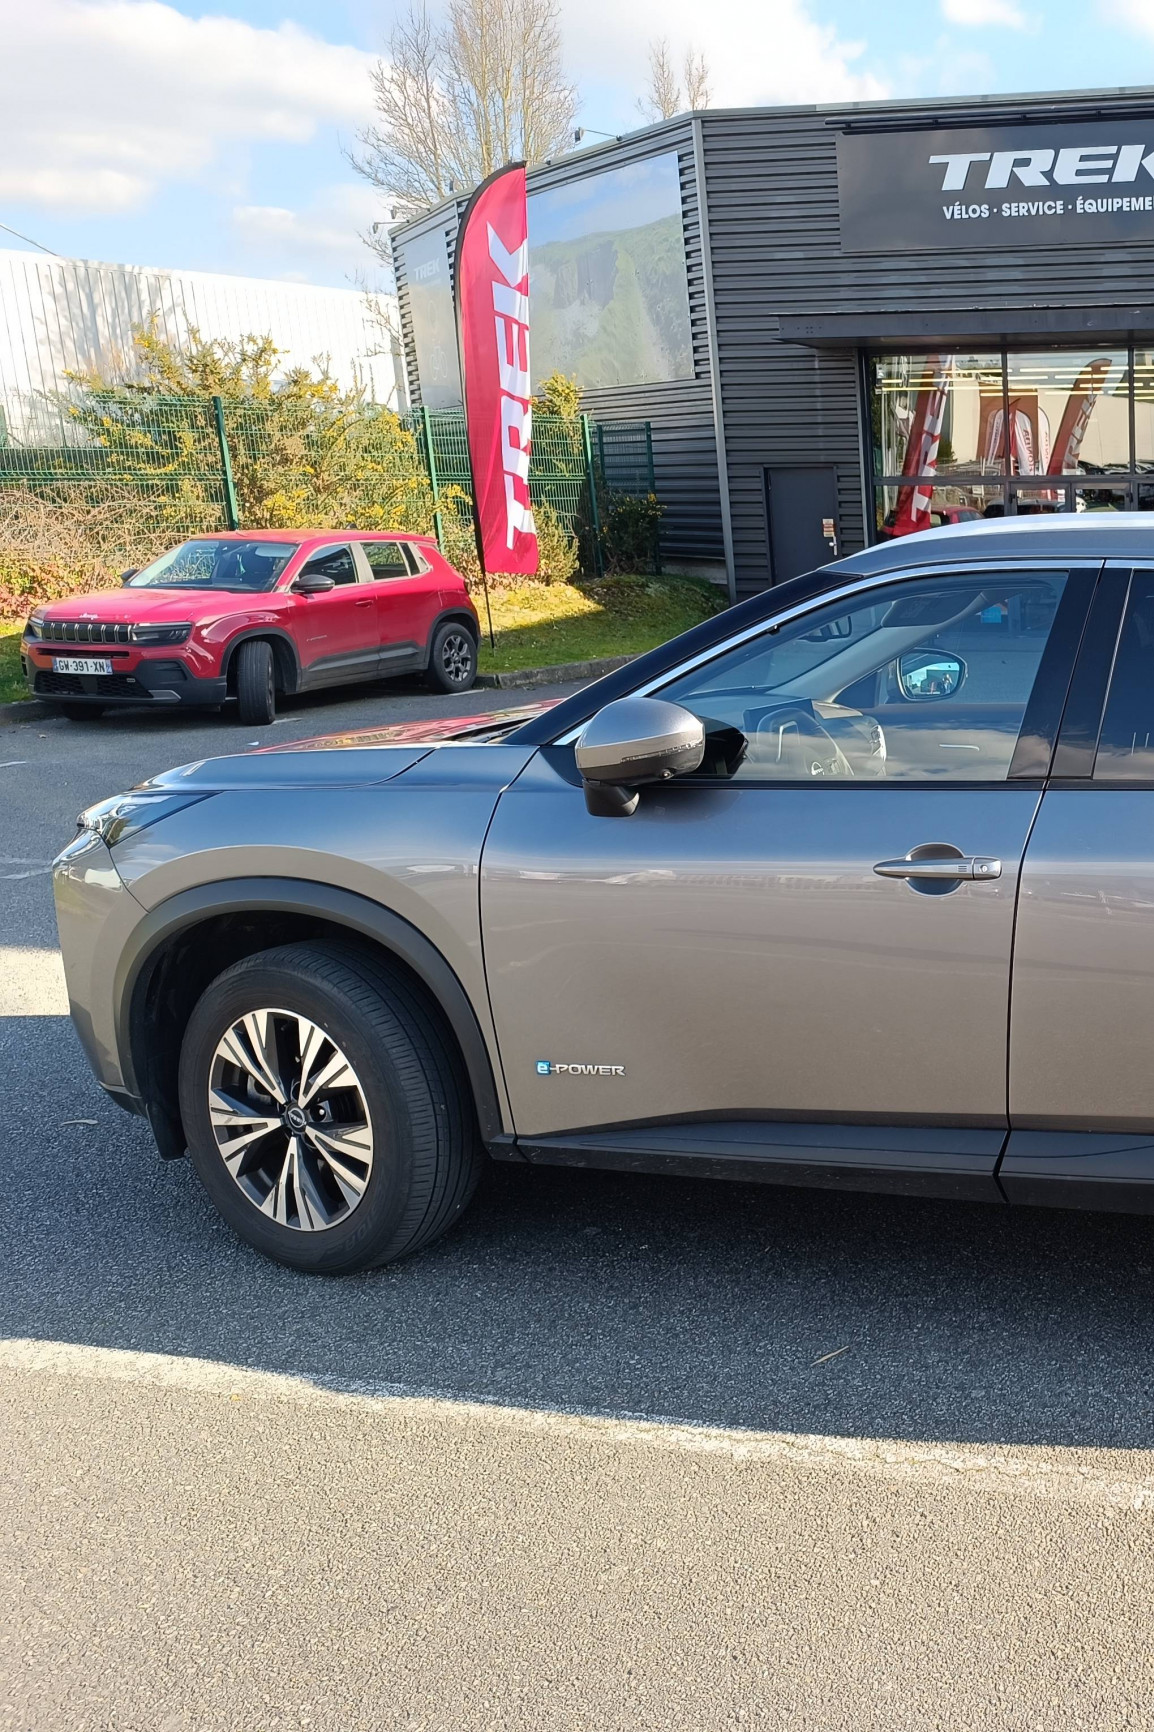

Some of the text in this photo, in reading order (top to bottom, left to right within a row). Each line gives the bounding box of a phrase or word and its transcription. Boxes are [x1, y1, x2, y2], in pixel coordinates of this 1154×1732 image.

[943, 201, 990, 220] VÉLOS
[1002, 200, 1064, 217] SERVICE
[413, 258, 440, 281] TREK
[486, 220, 537, 550] TREK
[58, 660, 106, 673] GW-391-XN
